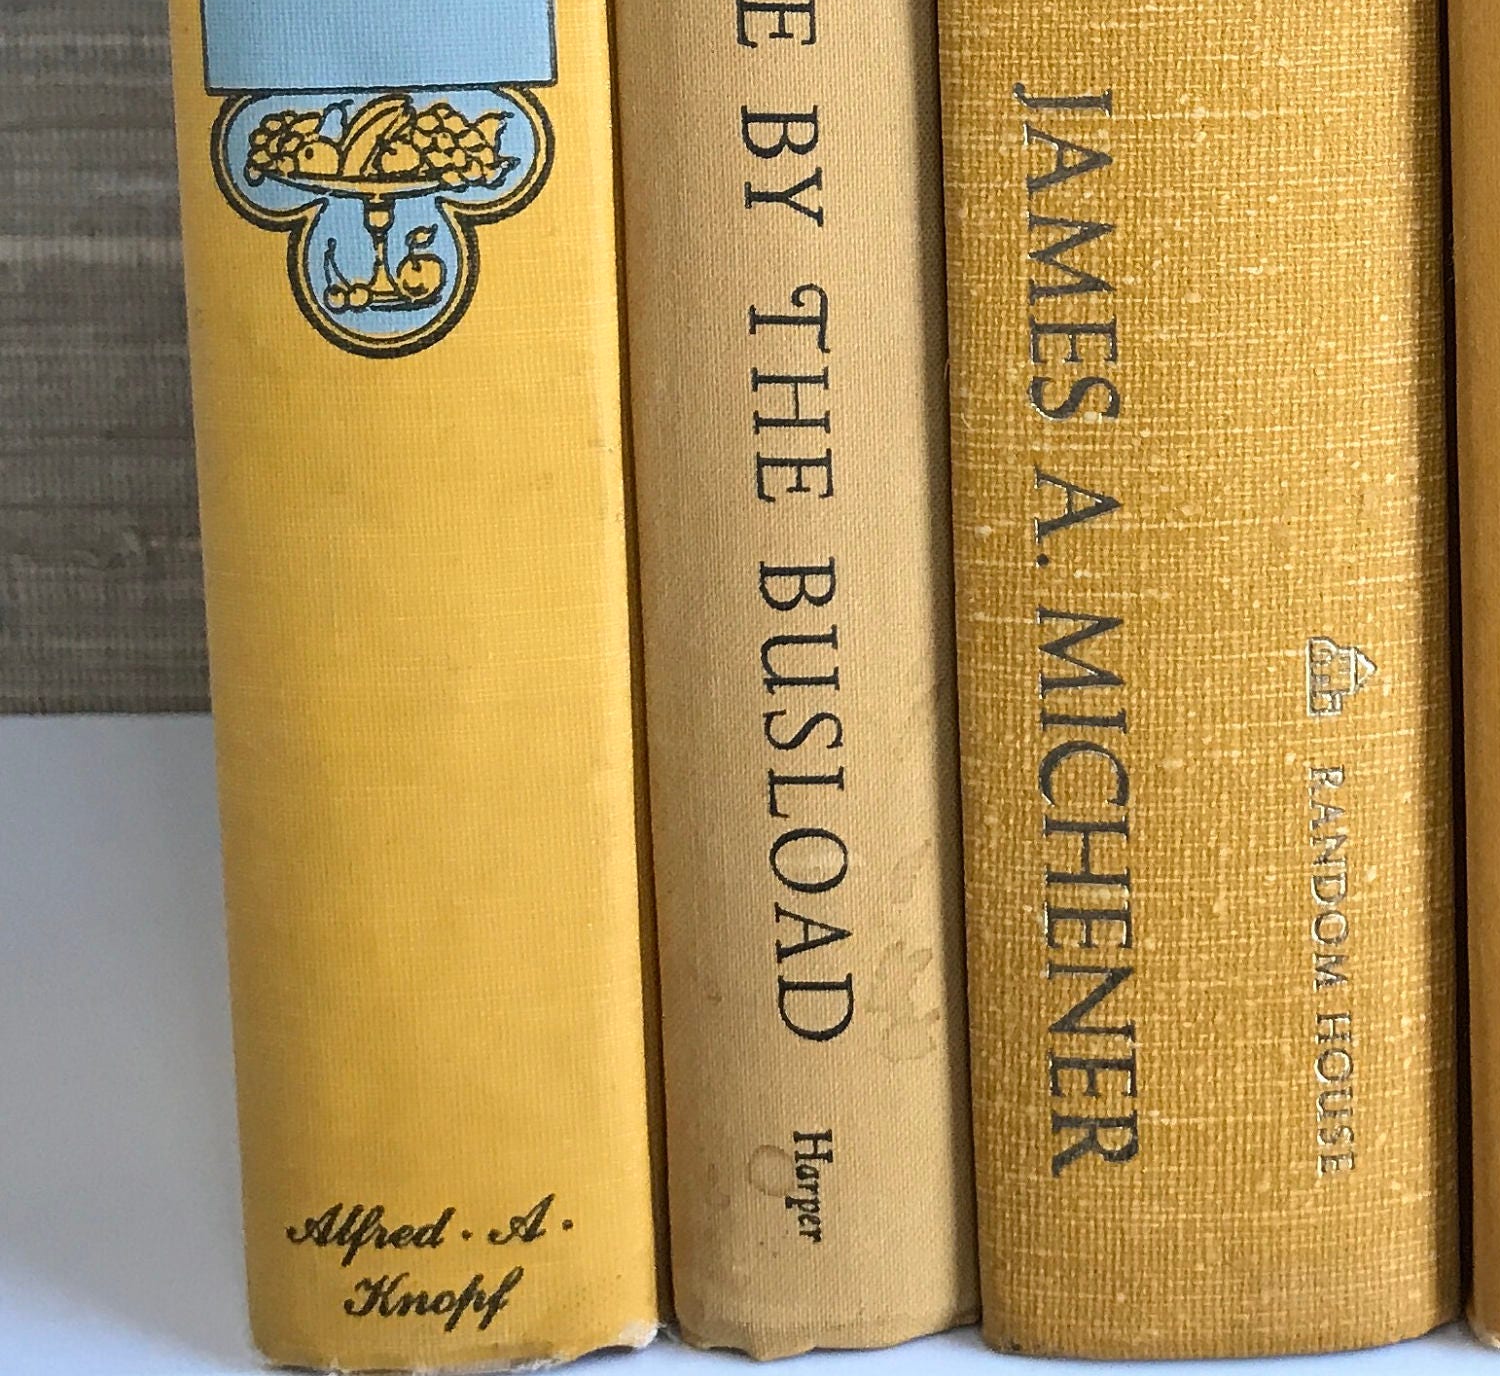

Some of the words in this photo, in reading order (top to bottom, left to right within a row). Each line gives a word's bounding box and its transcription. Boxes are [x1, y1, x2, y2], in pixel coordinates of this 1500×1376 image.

[738, 103, 825, 229] BY
[1012, 82, 1121, 421] JAMES
[746, 281, 836, 505] THE
[1031, 466, 1123, 568] A.
[756, 555, 857, 1044] BUSLOAD
[1034, 606, 1140, 1179] MICHENER
[1306, 764, 1350, 990] RANDOM
[784, 1128, 834, 1243] Harper
[1314, 1010, 1357, 1177] HOUSE
[343, 1265, 525, 1333] Knopf
